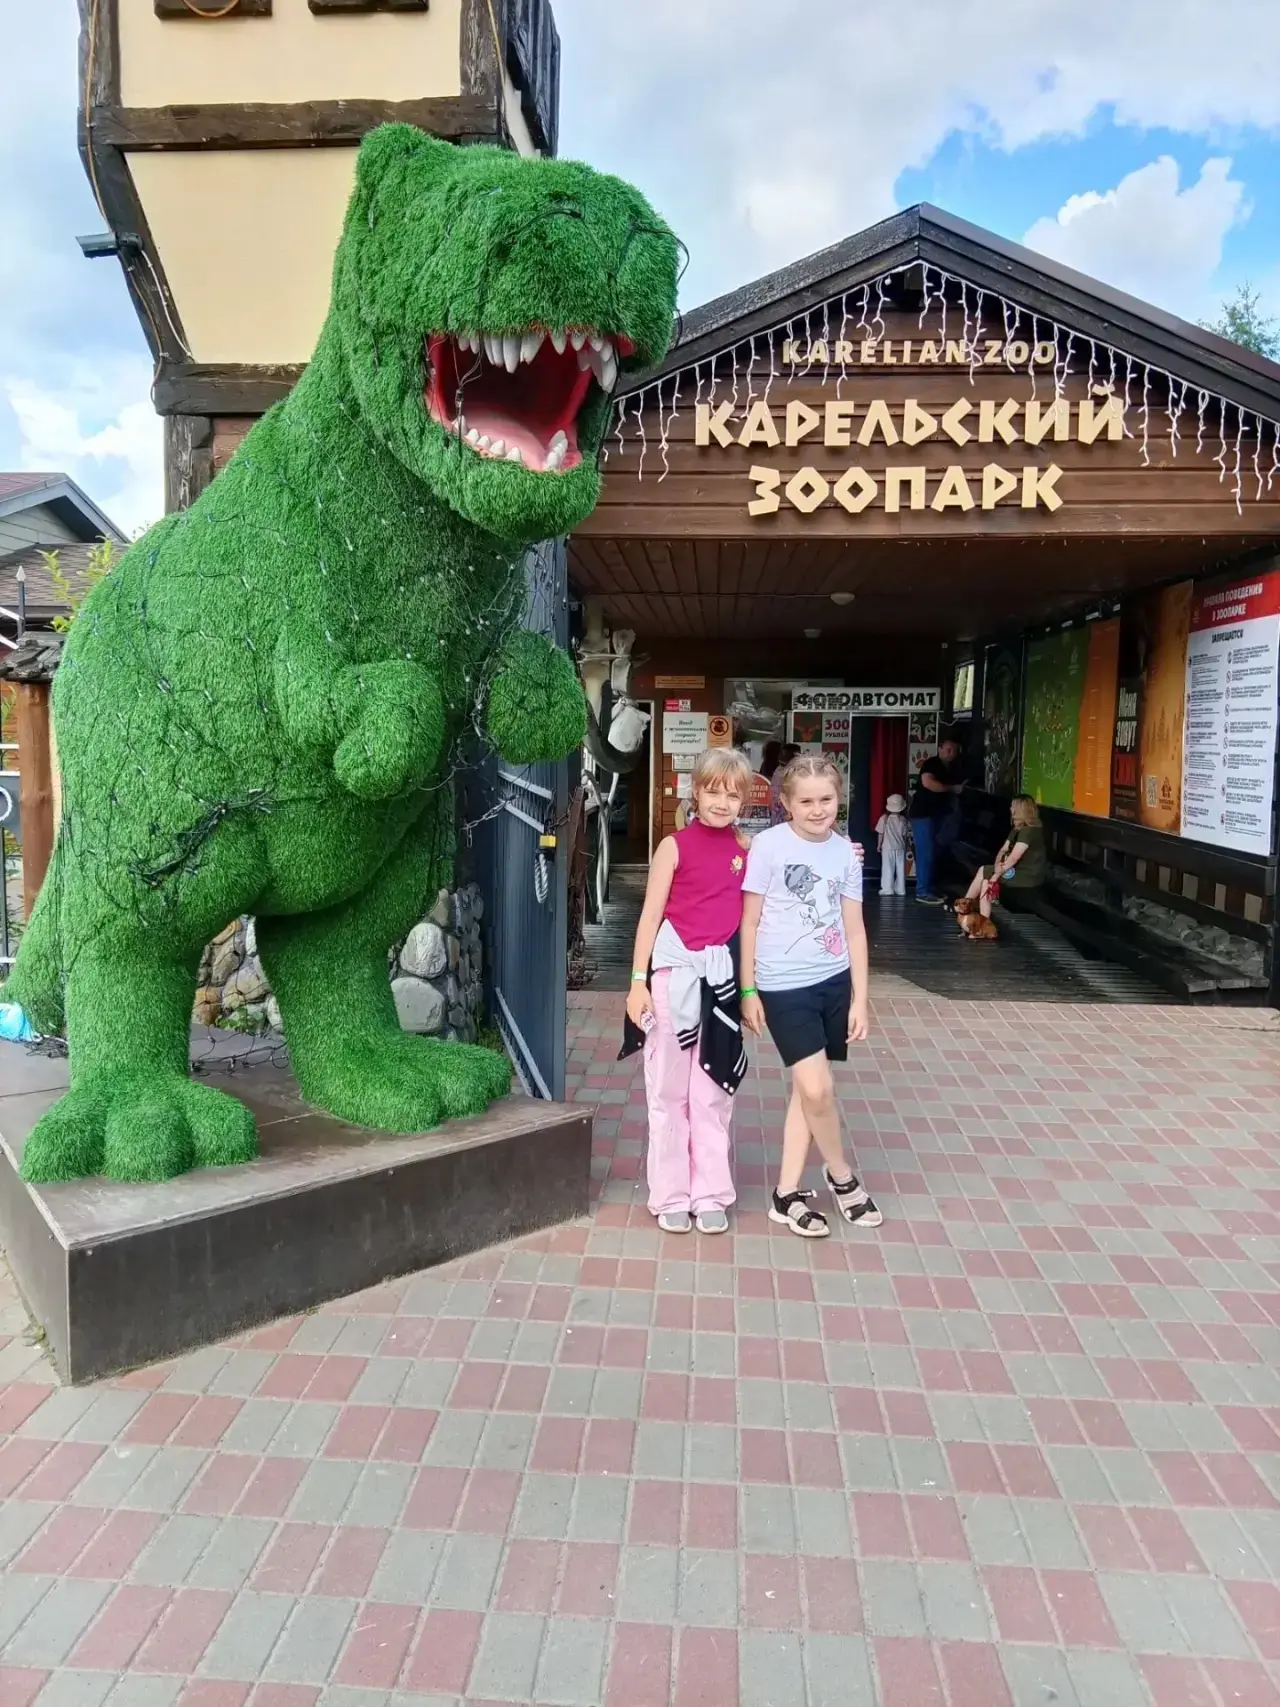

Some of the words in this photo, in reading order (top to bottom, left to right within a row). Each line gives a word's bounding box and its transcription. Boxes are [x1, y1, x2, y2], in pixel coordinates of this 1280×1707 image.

[782, 339, 965, 364] KARELIAN
[985, 340, 1057, 364] ZOO
[695, 384, 1124, 447] КАРЕЛЬСКИЙ
[748, 463, 1064, 516] ЗООПАРК
[1225, 583, 1262, 600] ПОВЕДЕНИЯ
[1216, 604, 1246, 620] ЗООПАРКЕ
[1212, 630, 1243, 643] ЗАПРЕЩАЕТСЯ
[796, 692, 936, 707] ФОТОАВТОМАТ
[825, 720, 849, 730] 300
